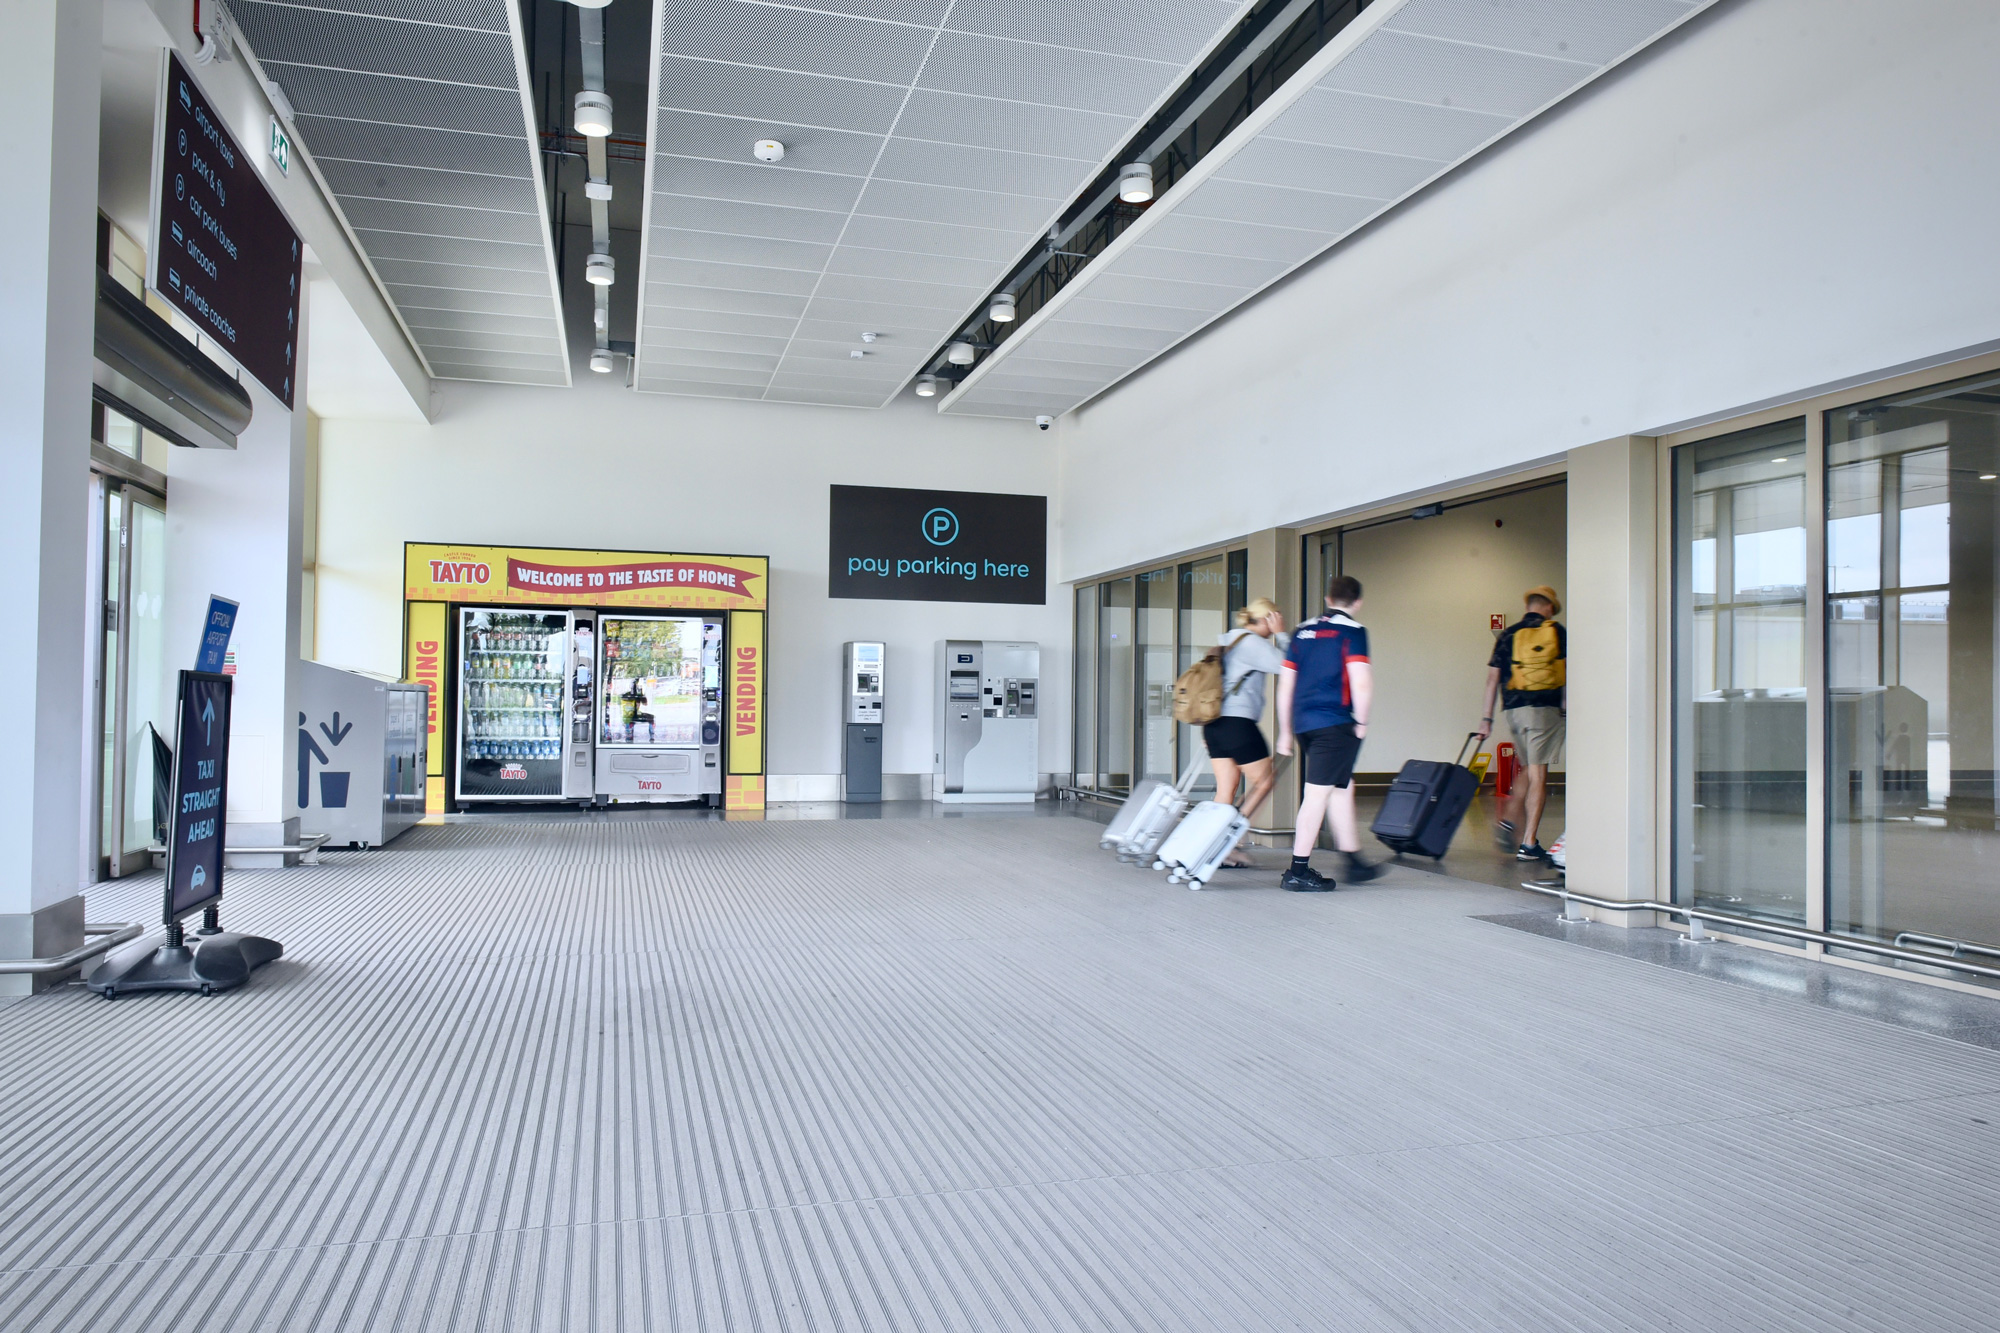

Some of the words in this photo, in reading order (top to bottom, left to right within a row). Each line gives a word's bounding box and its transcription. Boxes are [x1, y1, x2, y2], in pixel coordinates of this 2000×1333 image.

[195, 106, 218, 148] airport
[220, 137, 234, 169] taxis
[192, 151, 209, 182] park
[210, 169, 215, 191] &
[216, 179, 226, 207] fly
[189, 195, 202, 219] car
[202, 211, 218, 240] park
[219, 225, 237, 261] buses
[187, 239, 217, 281] aircoach
[184, 283, 209, 318] private
[209, 308, 236, 343] coaches
[430, 561, 490, 584] TAYTO
[517, 567, 583, 587] WELCOME
[588, 573, 604, 587] TO
[608, 571, 633, 586] THE
[637, 569, 674, 584] TASTE
[678, 569, 695, 582] OF
[698, 569, 736, 588] HOME
[848, 557, 889, 577] pay
[897, 556, 977, 581] parking
[984, 558, 1030, 578] here
[206, 631, 227, 646] AIRPORT
[736, 647, 756, 737] VENDING
[197, 759, 215, 780] TAXI
[500, 769, 527, 779] TAYTO
[638, 780, 662, 790] TAYTO
[182, 787, 221, 814] STRAIGHT
[187, 818, 215, 843] AHEAD
